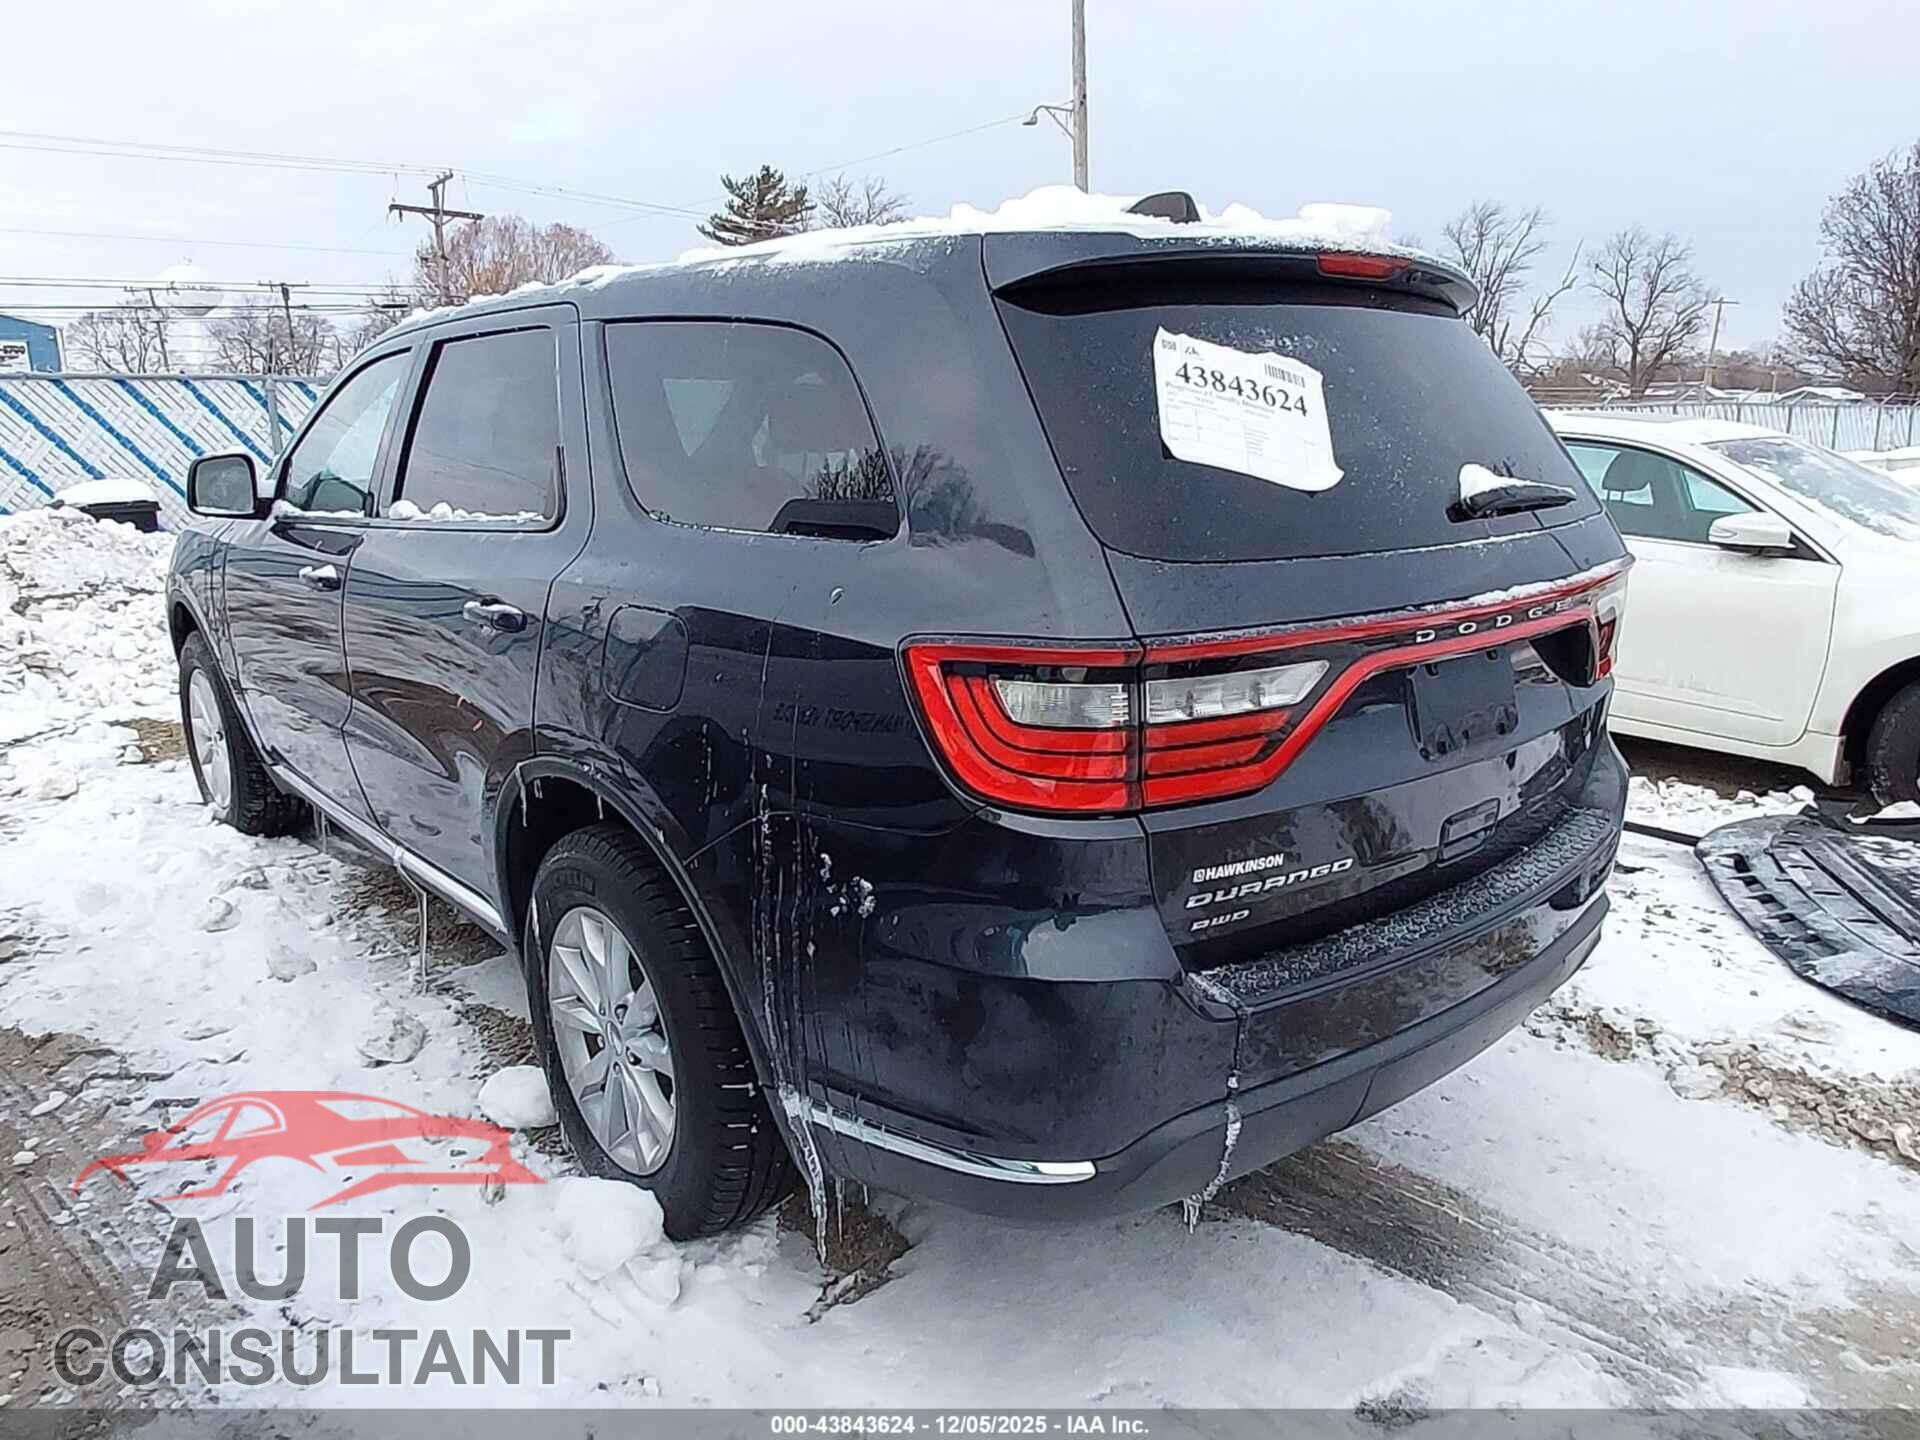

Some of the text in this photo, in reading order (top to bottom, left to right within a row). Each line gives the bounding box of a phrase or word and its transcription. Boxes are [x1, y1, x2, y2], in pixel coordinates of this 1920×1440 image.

[1175, 361, 1308, 417] 43843624
[1415, 601, 1570, 644] DODGE
[1185, 857, 1354, 909] DURANGO
[1205, 853, 1285, 881] HAWKINSON
